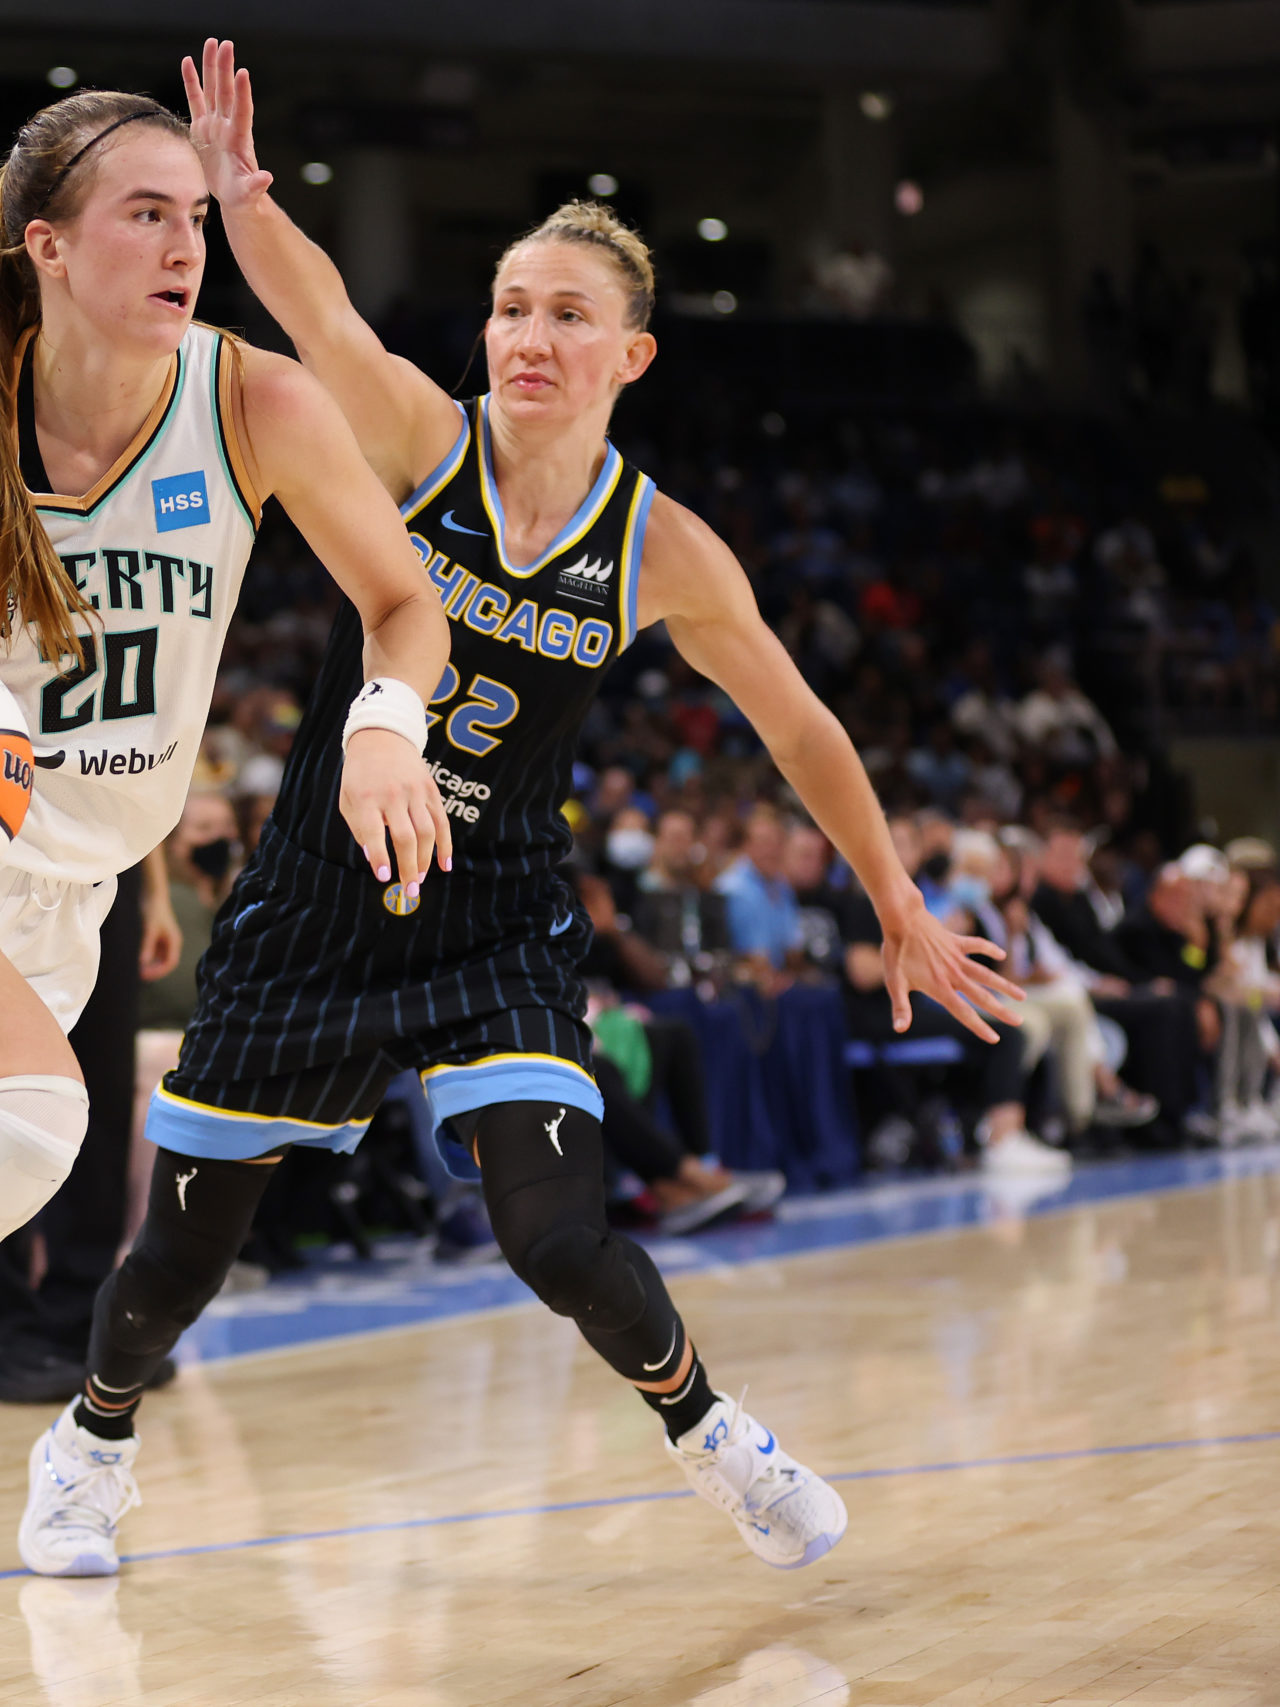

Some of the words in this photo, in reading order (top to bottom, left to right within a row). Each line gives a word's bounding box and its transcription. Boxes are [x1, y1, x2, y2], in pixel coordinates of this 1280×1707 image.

[160, 491, 203, 514] HSS
[38, 624, 159, 735] 20
[79, 740, 178, 775] Webull
